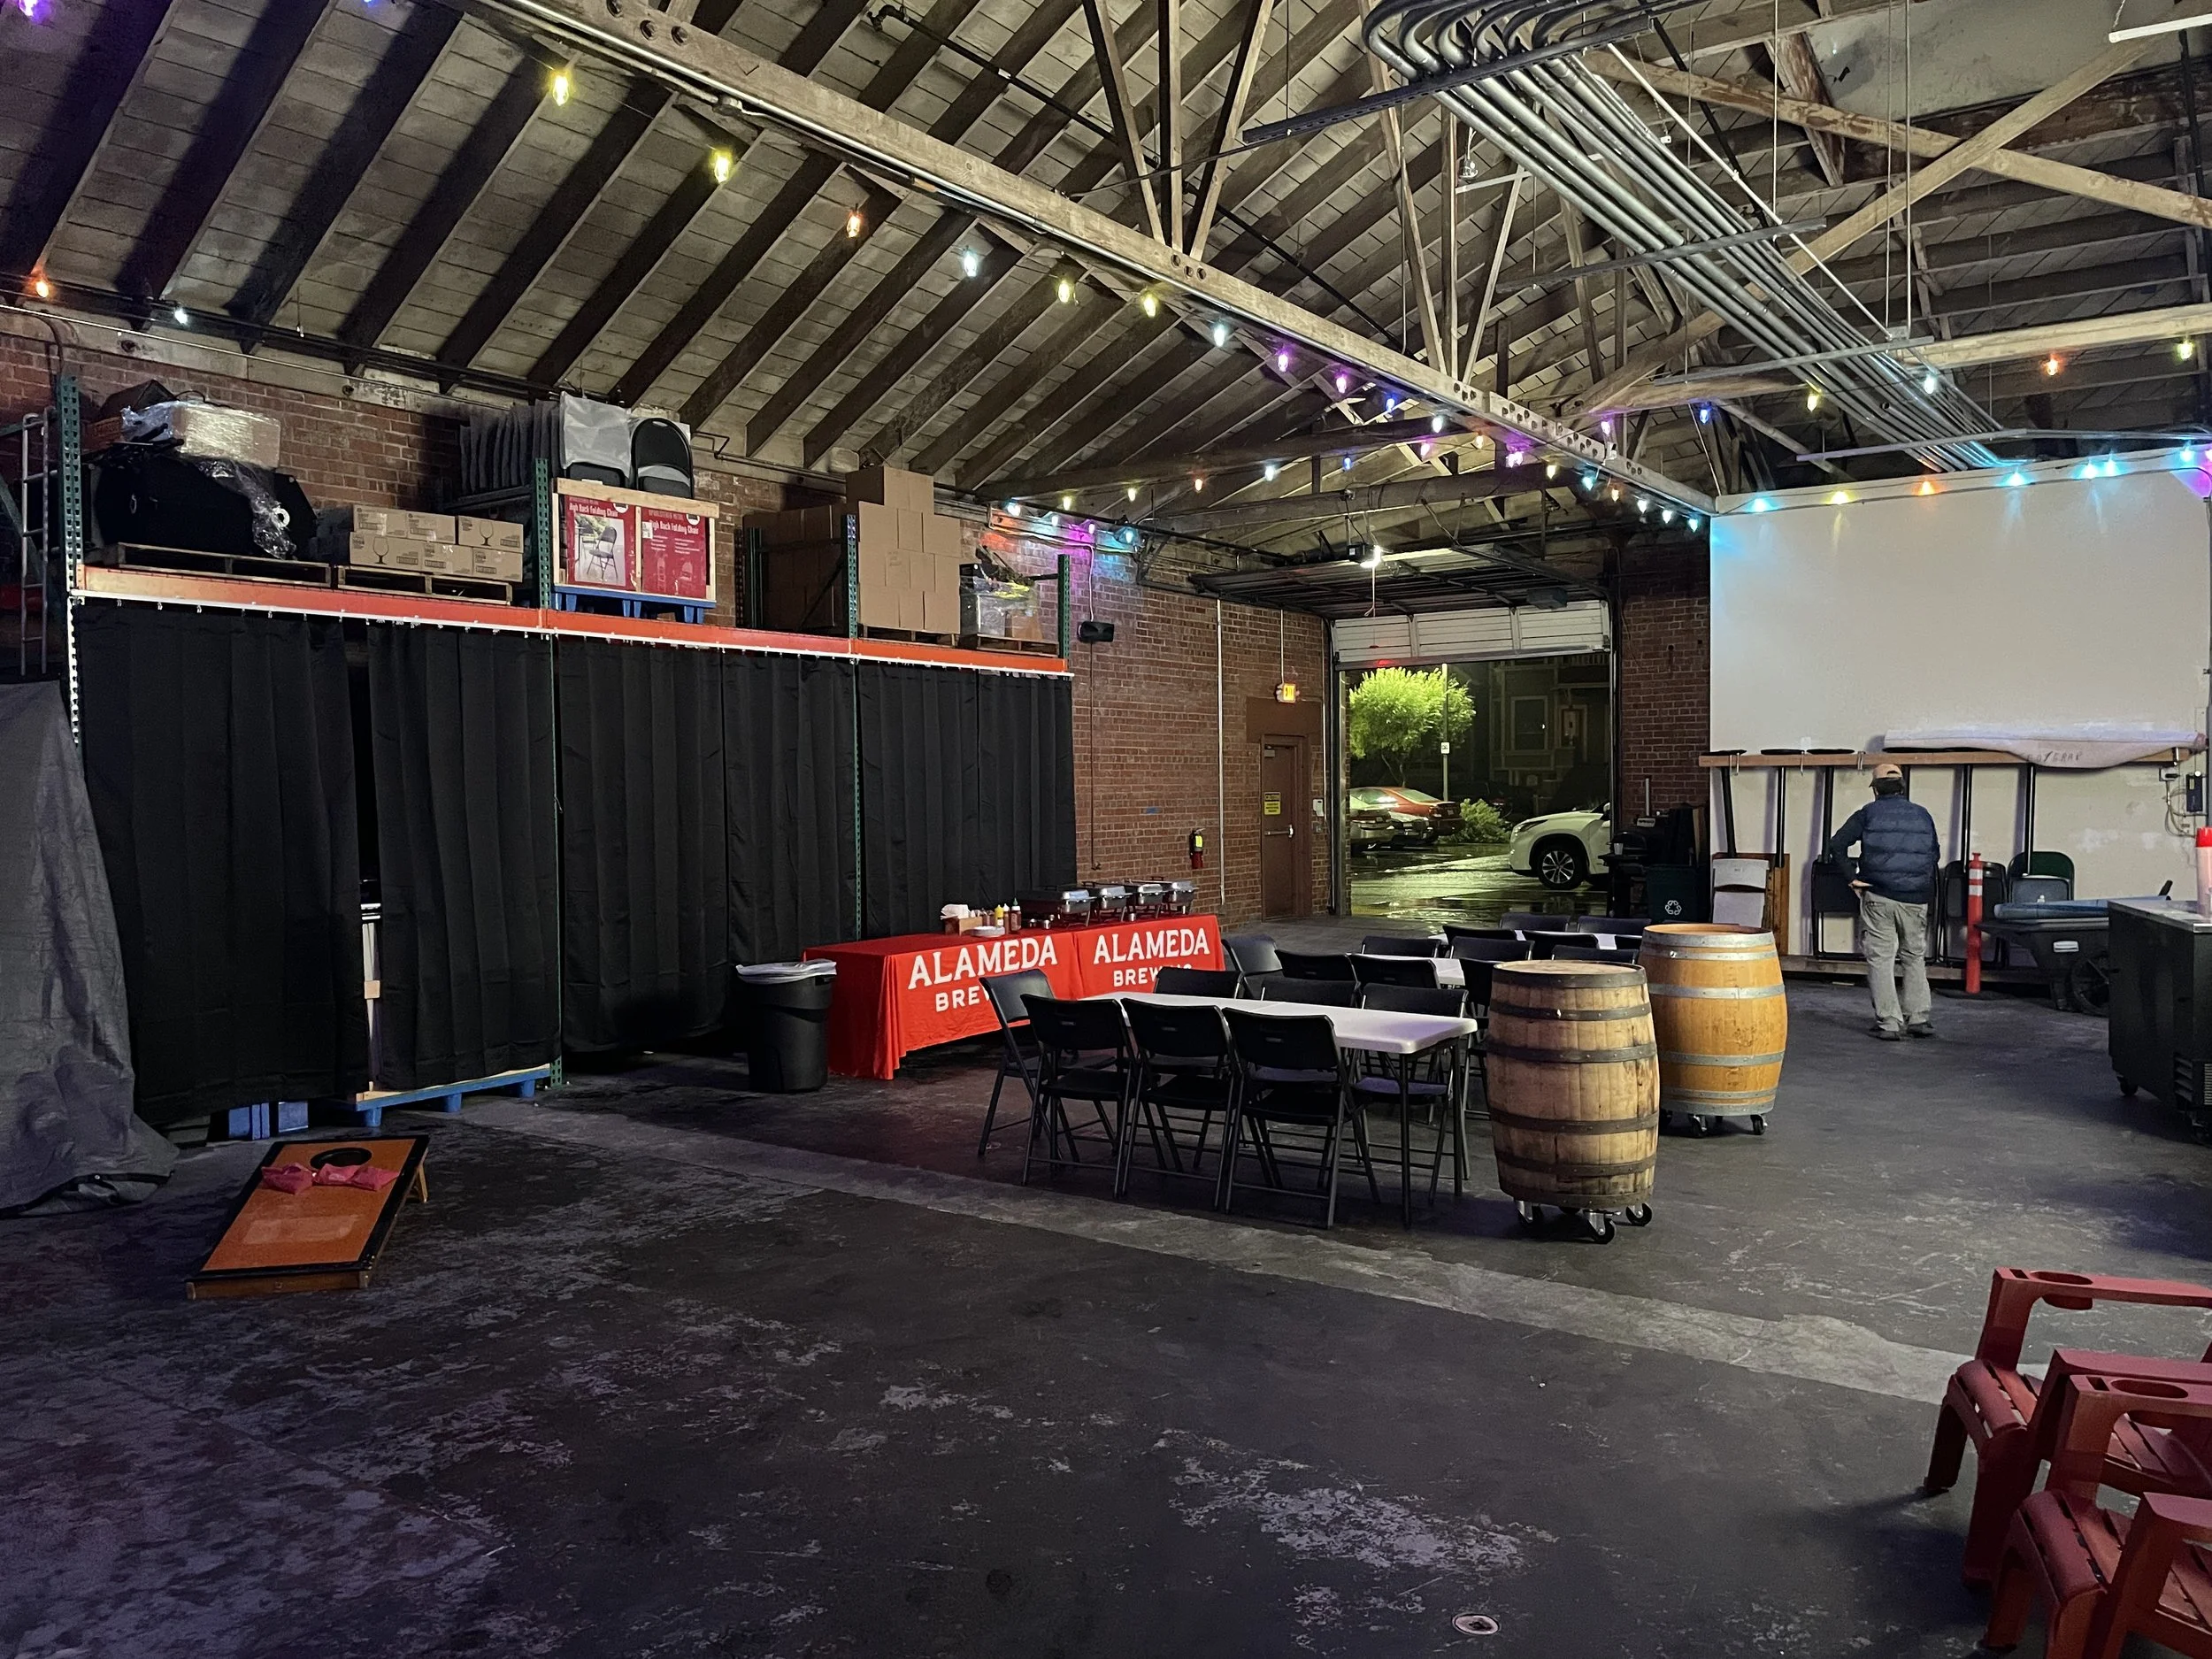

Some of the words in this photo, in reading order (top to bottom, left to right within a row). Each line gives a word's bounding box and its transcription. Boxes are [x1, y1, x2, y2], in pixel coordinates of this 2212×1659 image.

[1093, 927, 1210, 964] ALAMEDA
[907, 935, 1058, 990] ALAMEDA
[1113, 964, 1192, 987] BREW
[935, 985, 990, 1012] BRE
